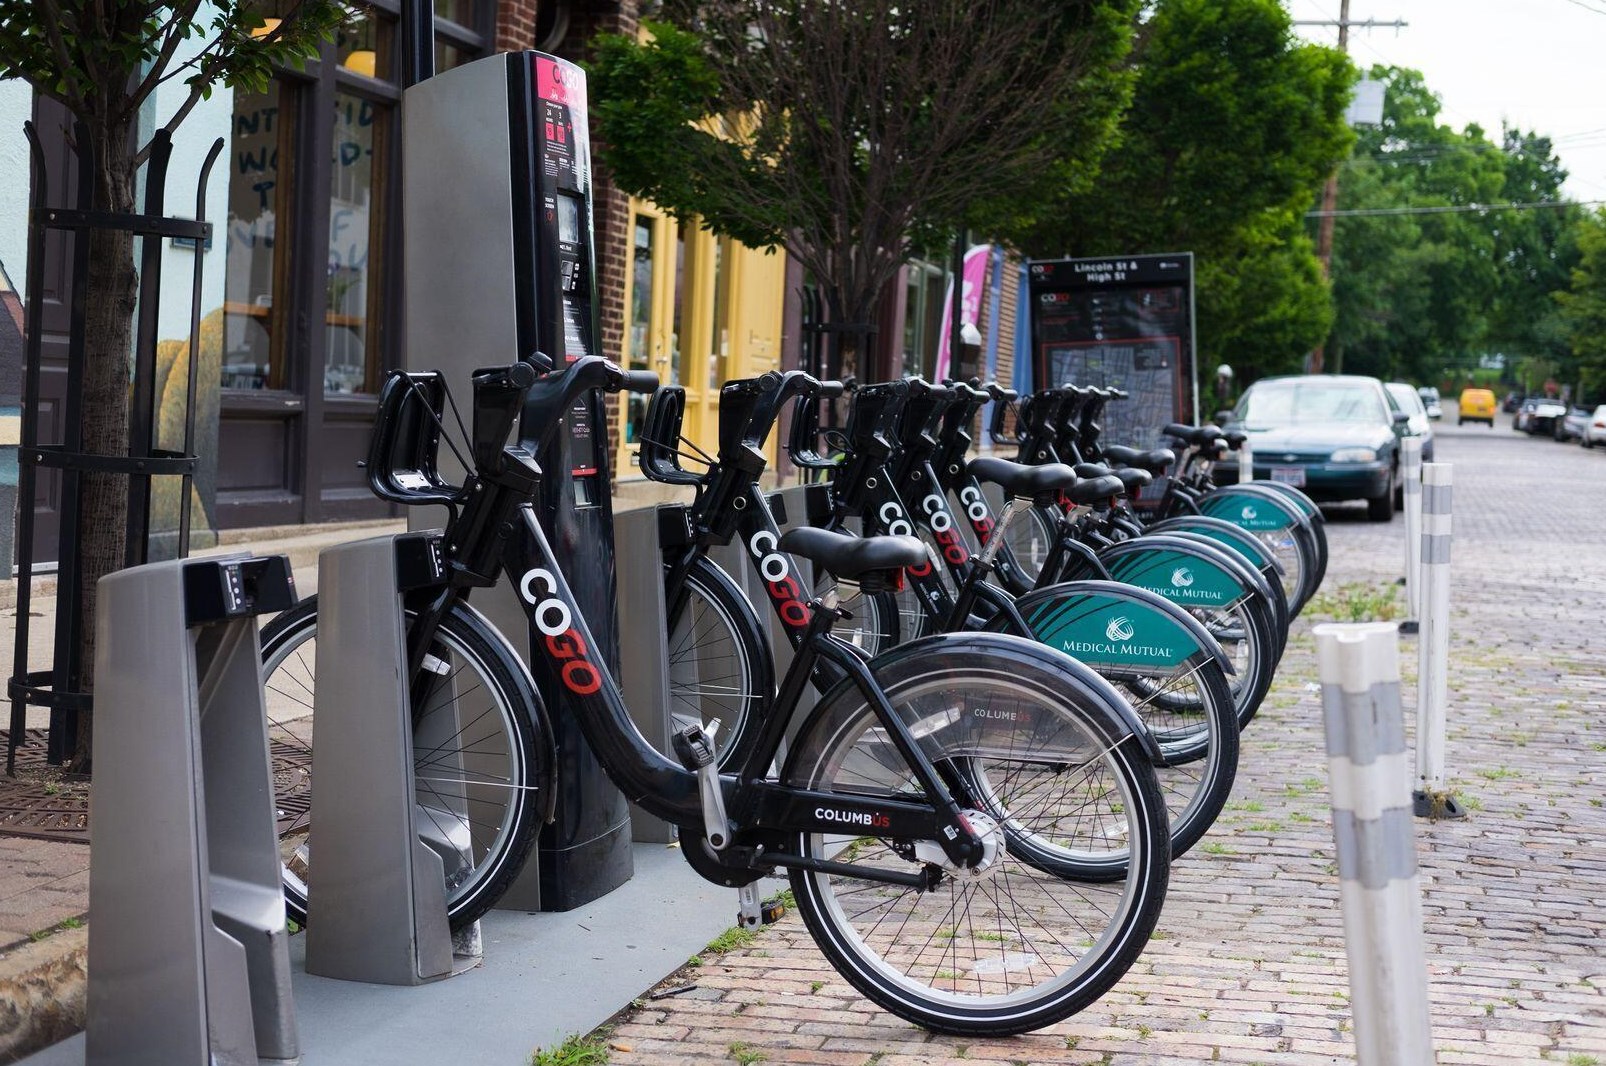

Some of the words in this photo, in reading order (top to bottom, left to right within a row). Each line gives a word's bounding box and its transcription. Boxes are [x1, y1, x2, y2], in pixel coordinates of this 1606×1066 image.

[1074, 263, 1114, 273] Lincoln
[1116, 262, 1127, 271] St
[1130, 261, 1138, 270] &
[1087, 273, 1112, 282] High
[1115, 272, 1126, 281] St
[879, 501, 932, 577] COO
[922, 494, 969, 565] COGO
[750, 530, 812, 627] COGO
[1138, 586, 1180, 597] EDICAL
[1182, 588, 1223, 600] MUTUAL
[520, 568, 602, 694] COGO
[1063, 640, 1118, 654] MEDICAL
[1120, 644, 1172, 657] MUTUAL
[814, 807, 891, 828] COLUMBUS
